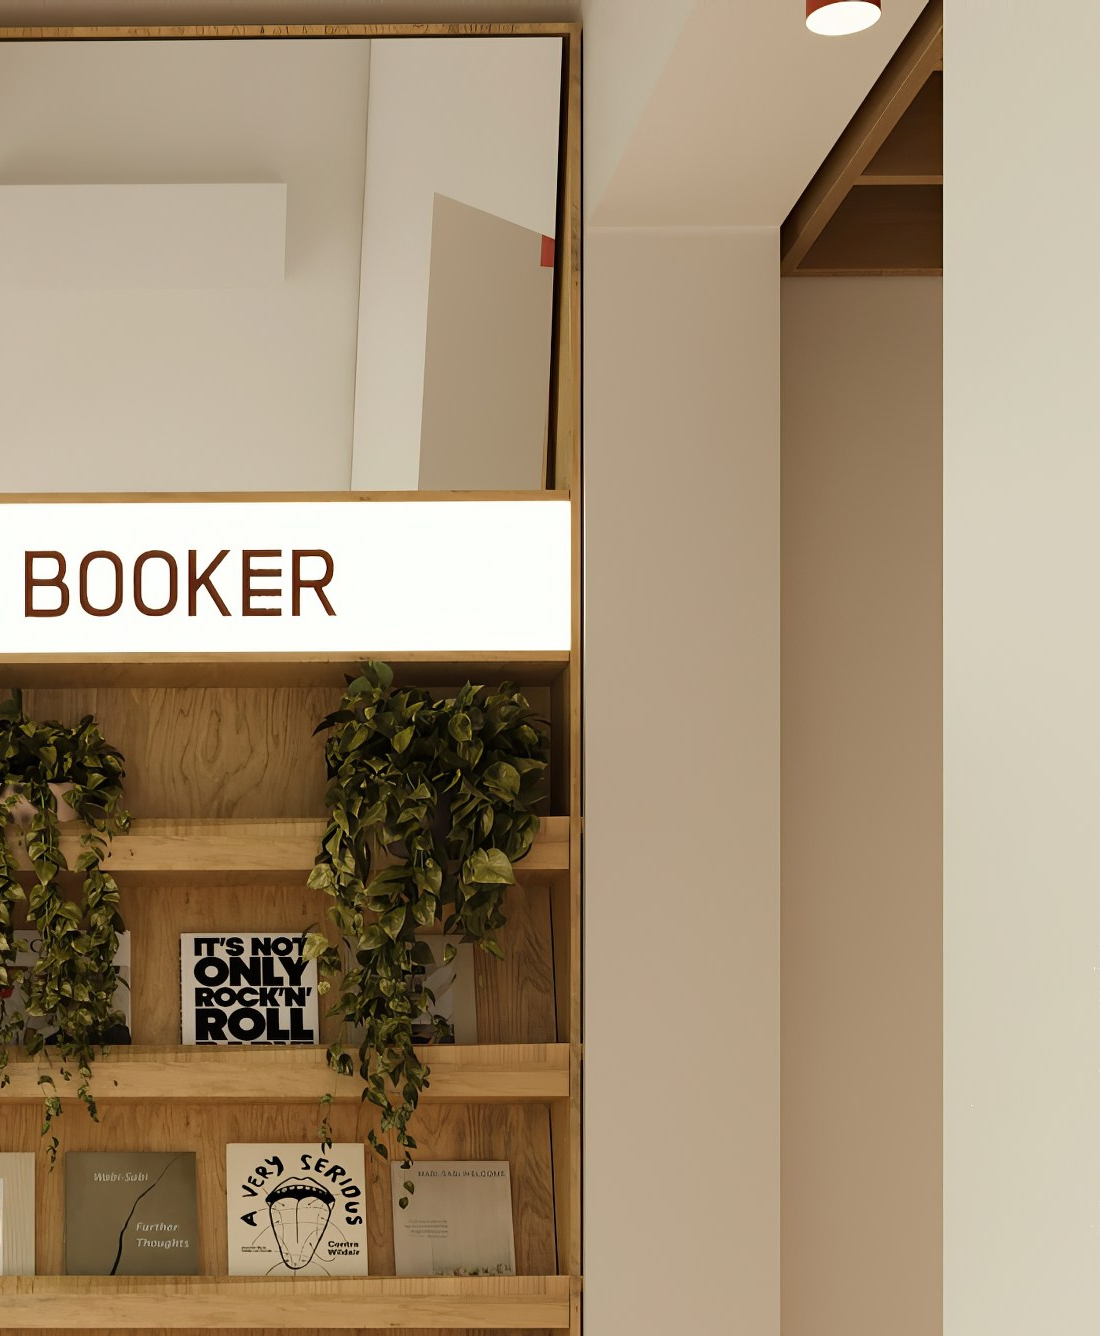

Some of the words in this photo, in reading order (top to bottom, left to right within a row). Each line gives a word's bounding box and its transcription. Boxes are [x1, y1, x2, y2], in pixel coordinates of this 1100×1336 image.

[25, 549, 337, 617] BOOKER
[194, 937, 244, 956] IT'S
[251, 937, 308, 956] NOT
[194, 956, 310, 987] ONLY
[195, 1007, 313, 1041] ROLL
[242, 1156, 284, 1198] VERY
[300, 1154, 363, 1225] SERIOUS
[240, 1210, 257, 1226] A
[136, 1238, 189, 1249] Thoughts
